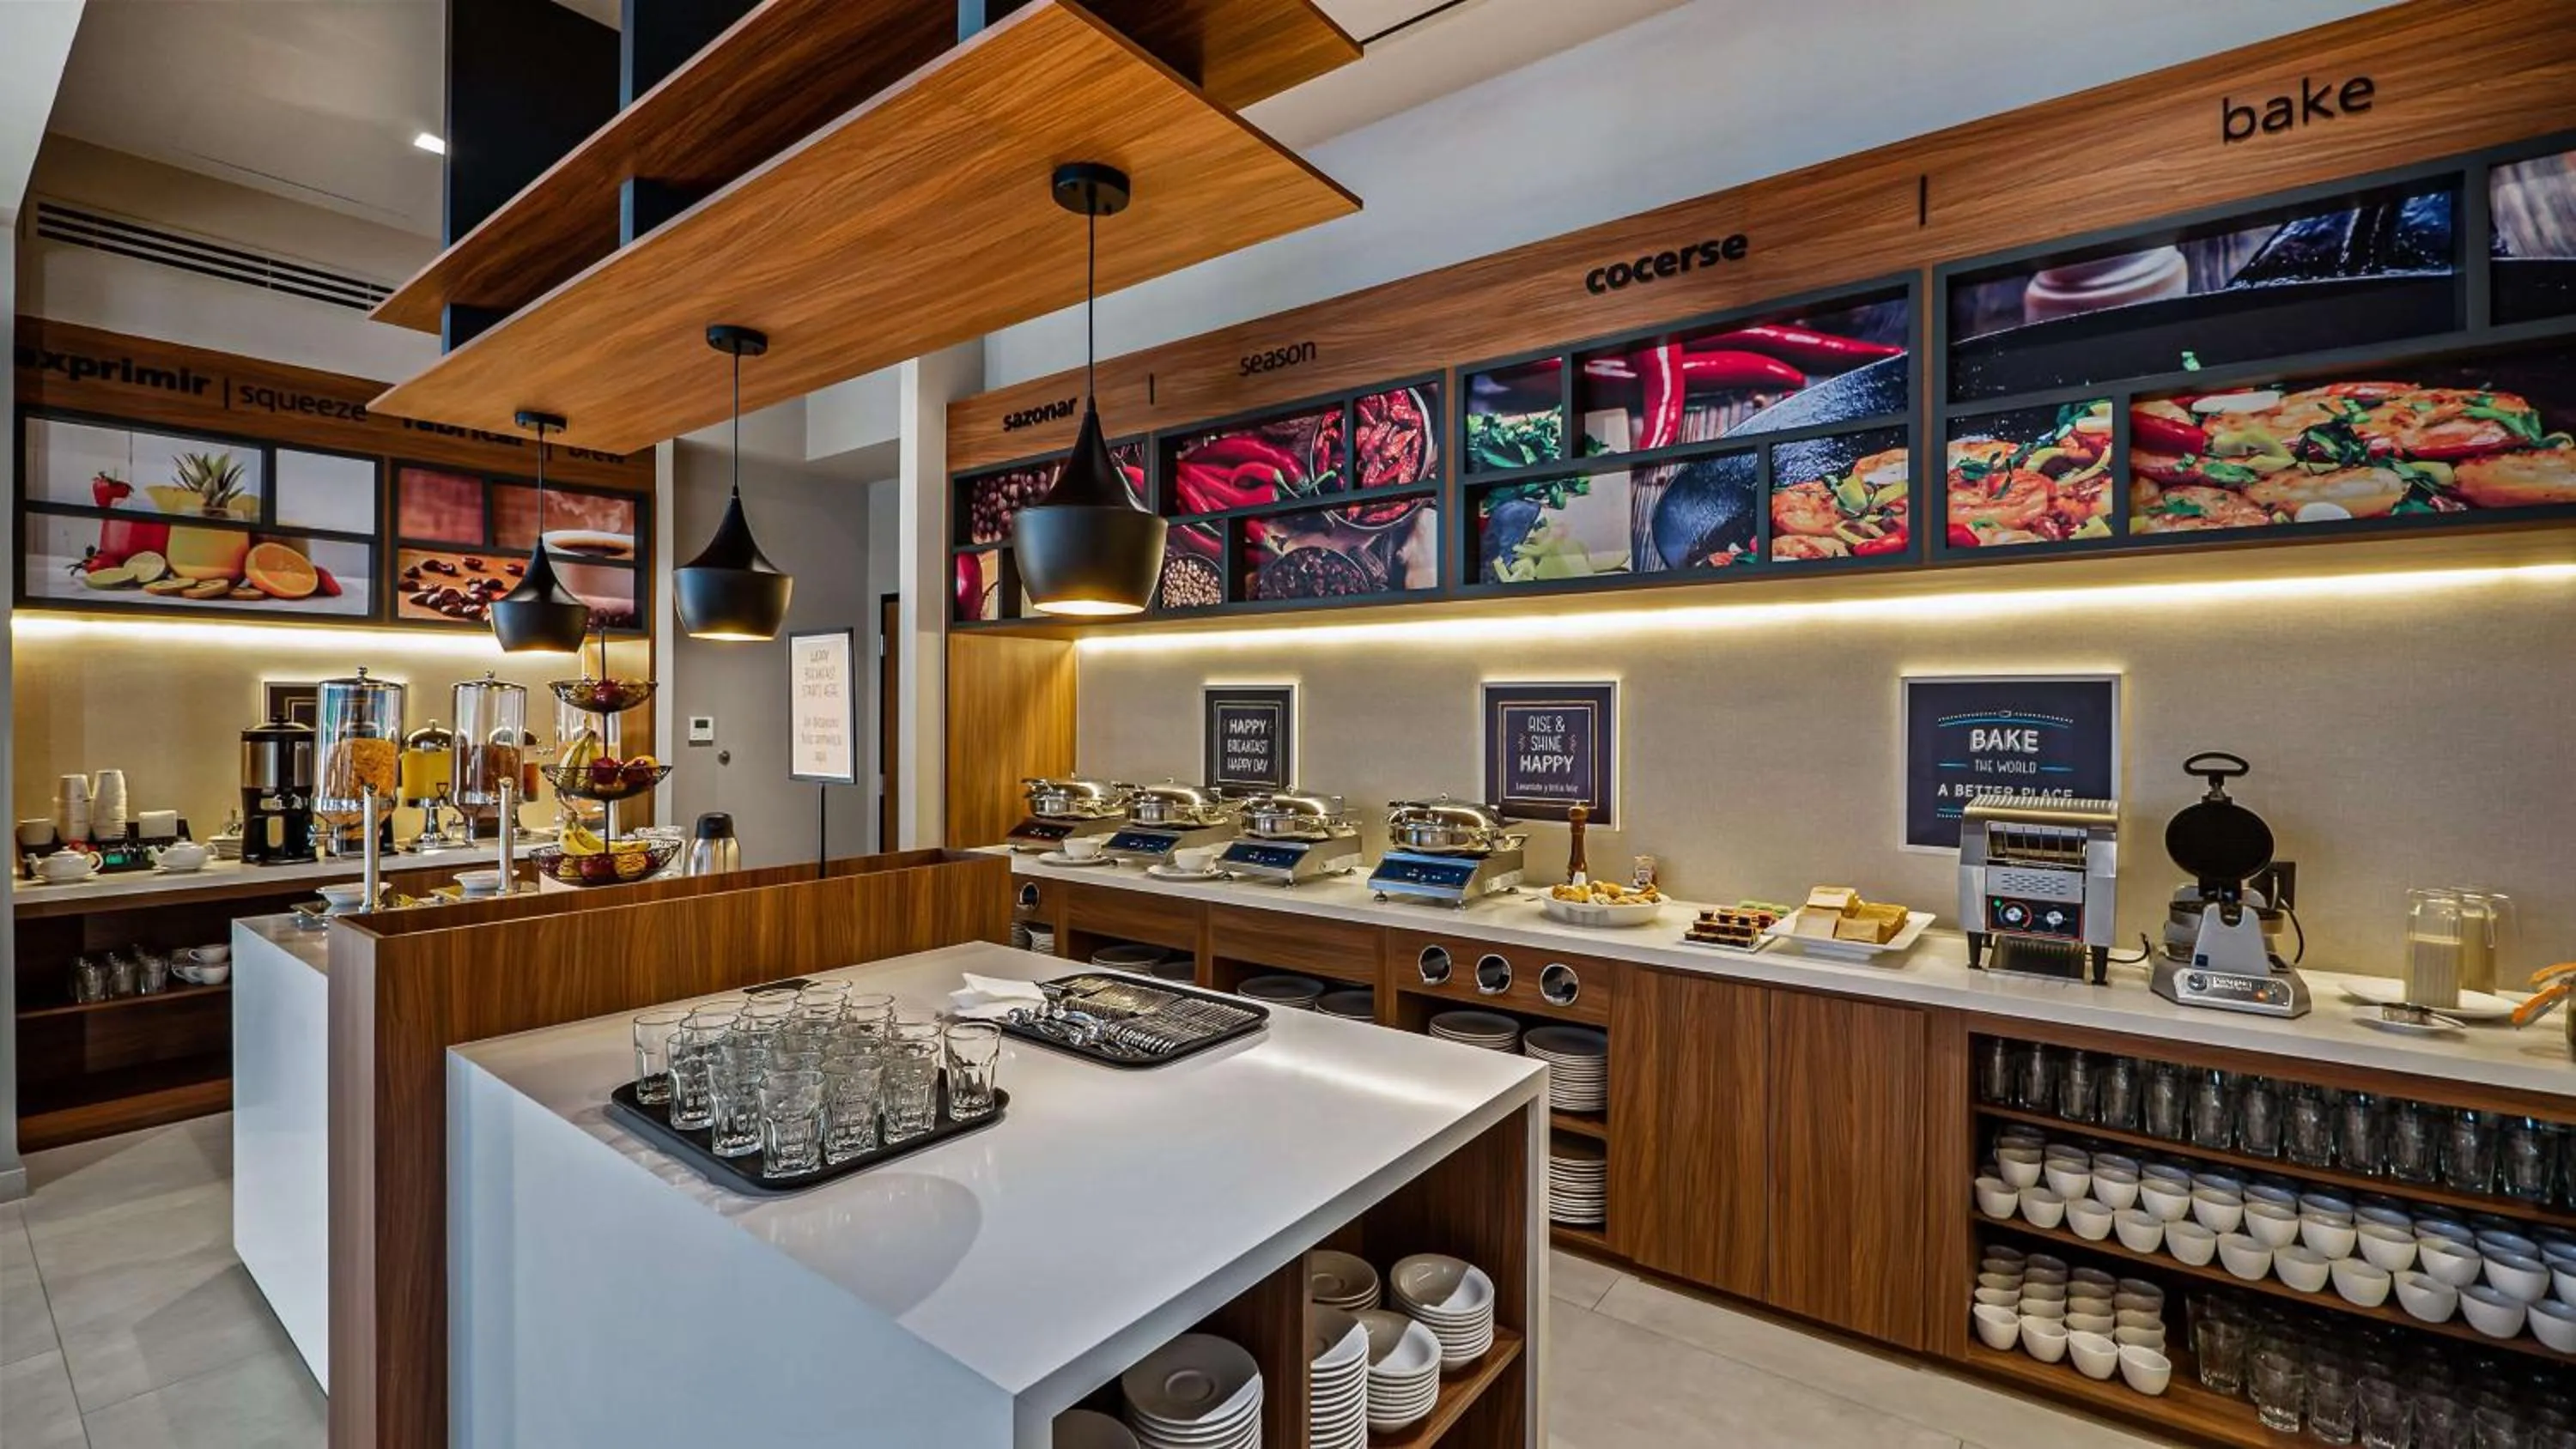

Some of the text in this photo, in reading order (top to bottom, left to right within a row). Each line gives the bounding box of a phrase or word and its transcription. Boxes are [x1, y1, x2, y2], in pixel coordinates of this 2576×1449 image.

[2222, 76, 2375, 144] bake
[1586, 233, 1748, 294] cocerse
[1238, 341, 1316, 378] season
[240, 385, 368, 421] squeeze
[1003, 397, 1077, 432] sazonar
[1229, 719, 1267, 734] HAPPY
[1528, 715, 1565, 733] RISE &
[1227, 739, 1268, 755] BREAKFAST
[1531, 735, 1562, 753] SHINE
[1970, 729, 2039, 753] BAKE
[1227, 756, 1268, 773] HAPPY DAY
[1520, 755, 1574, 773] HAPPY
[1975, 759, 2036, 774] THE WORLD
[1937, 784, 2074, 798] A BETTER PLACE
